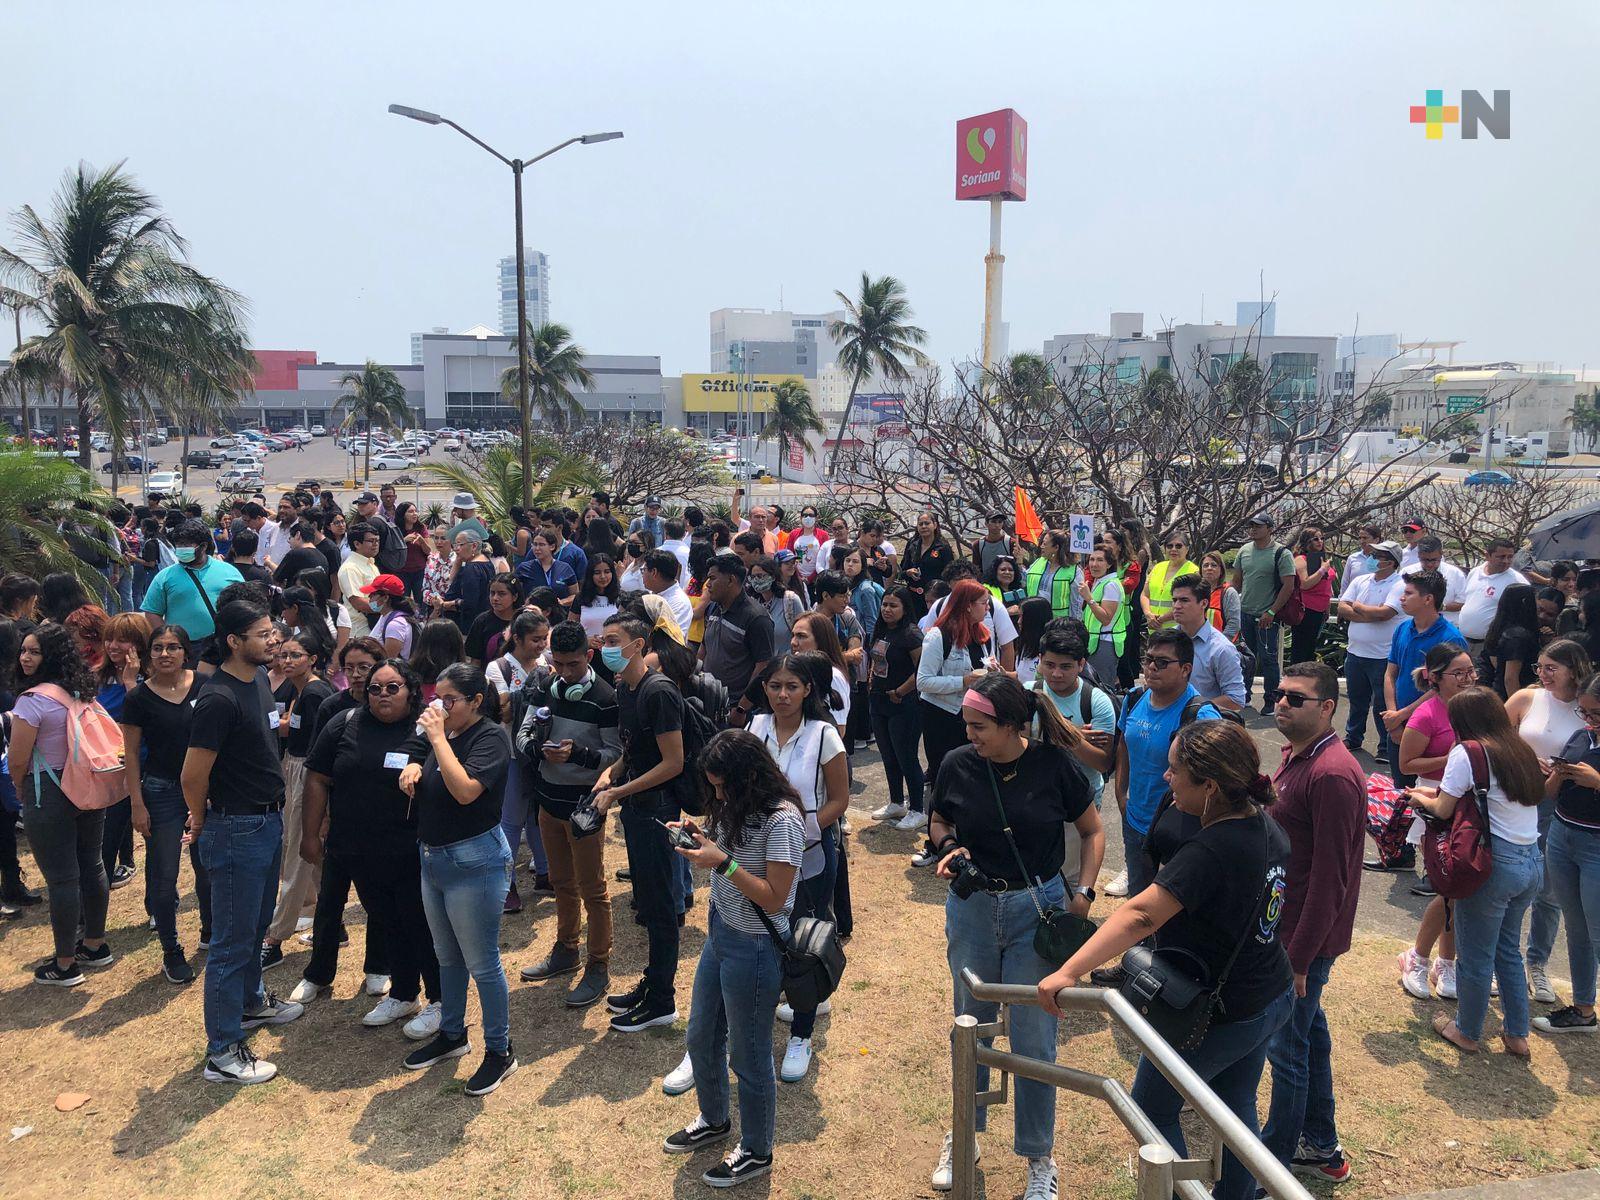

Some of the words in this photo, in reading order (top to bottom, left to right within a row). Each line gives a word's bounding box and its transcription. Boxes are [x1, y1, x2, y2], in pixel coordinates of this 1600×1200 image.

[960, 170, 1001, 187] Soriana
[701, 379, 785, 393] OfficeMa
[1073, 540, 1091, 550] CADI
